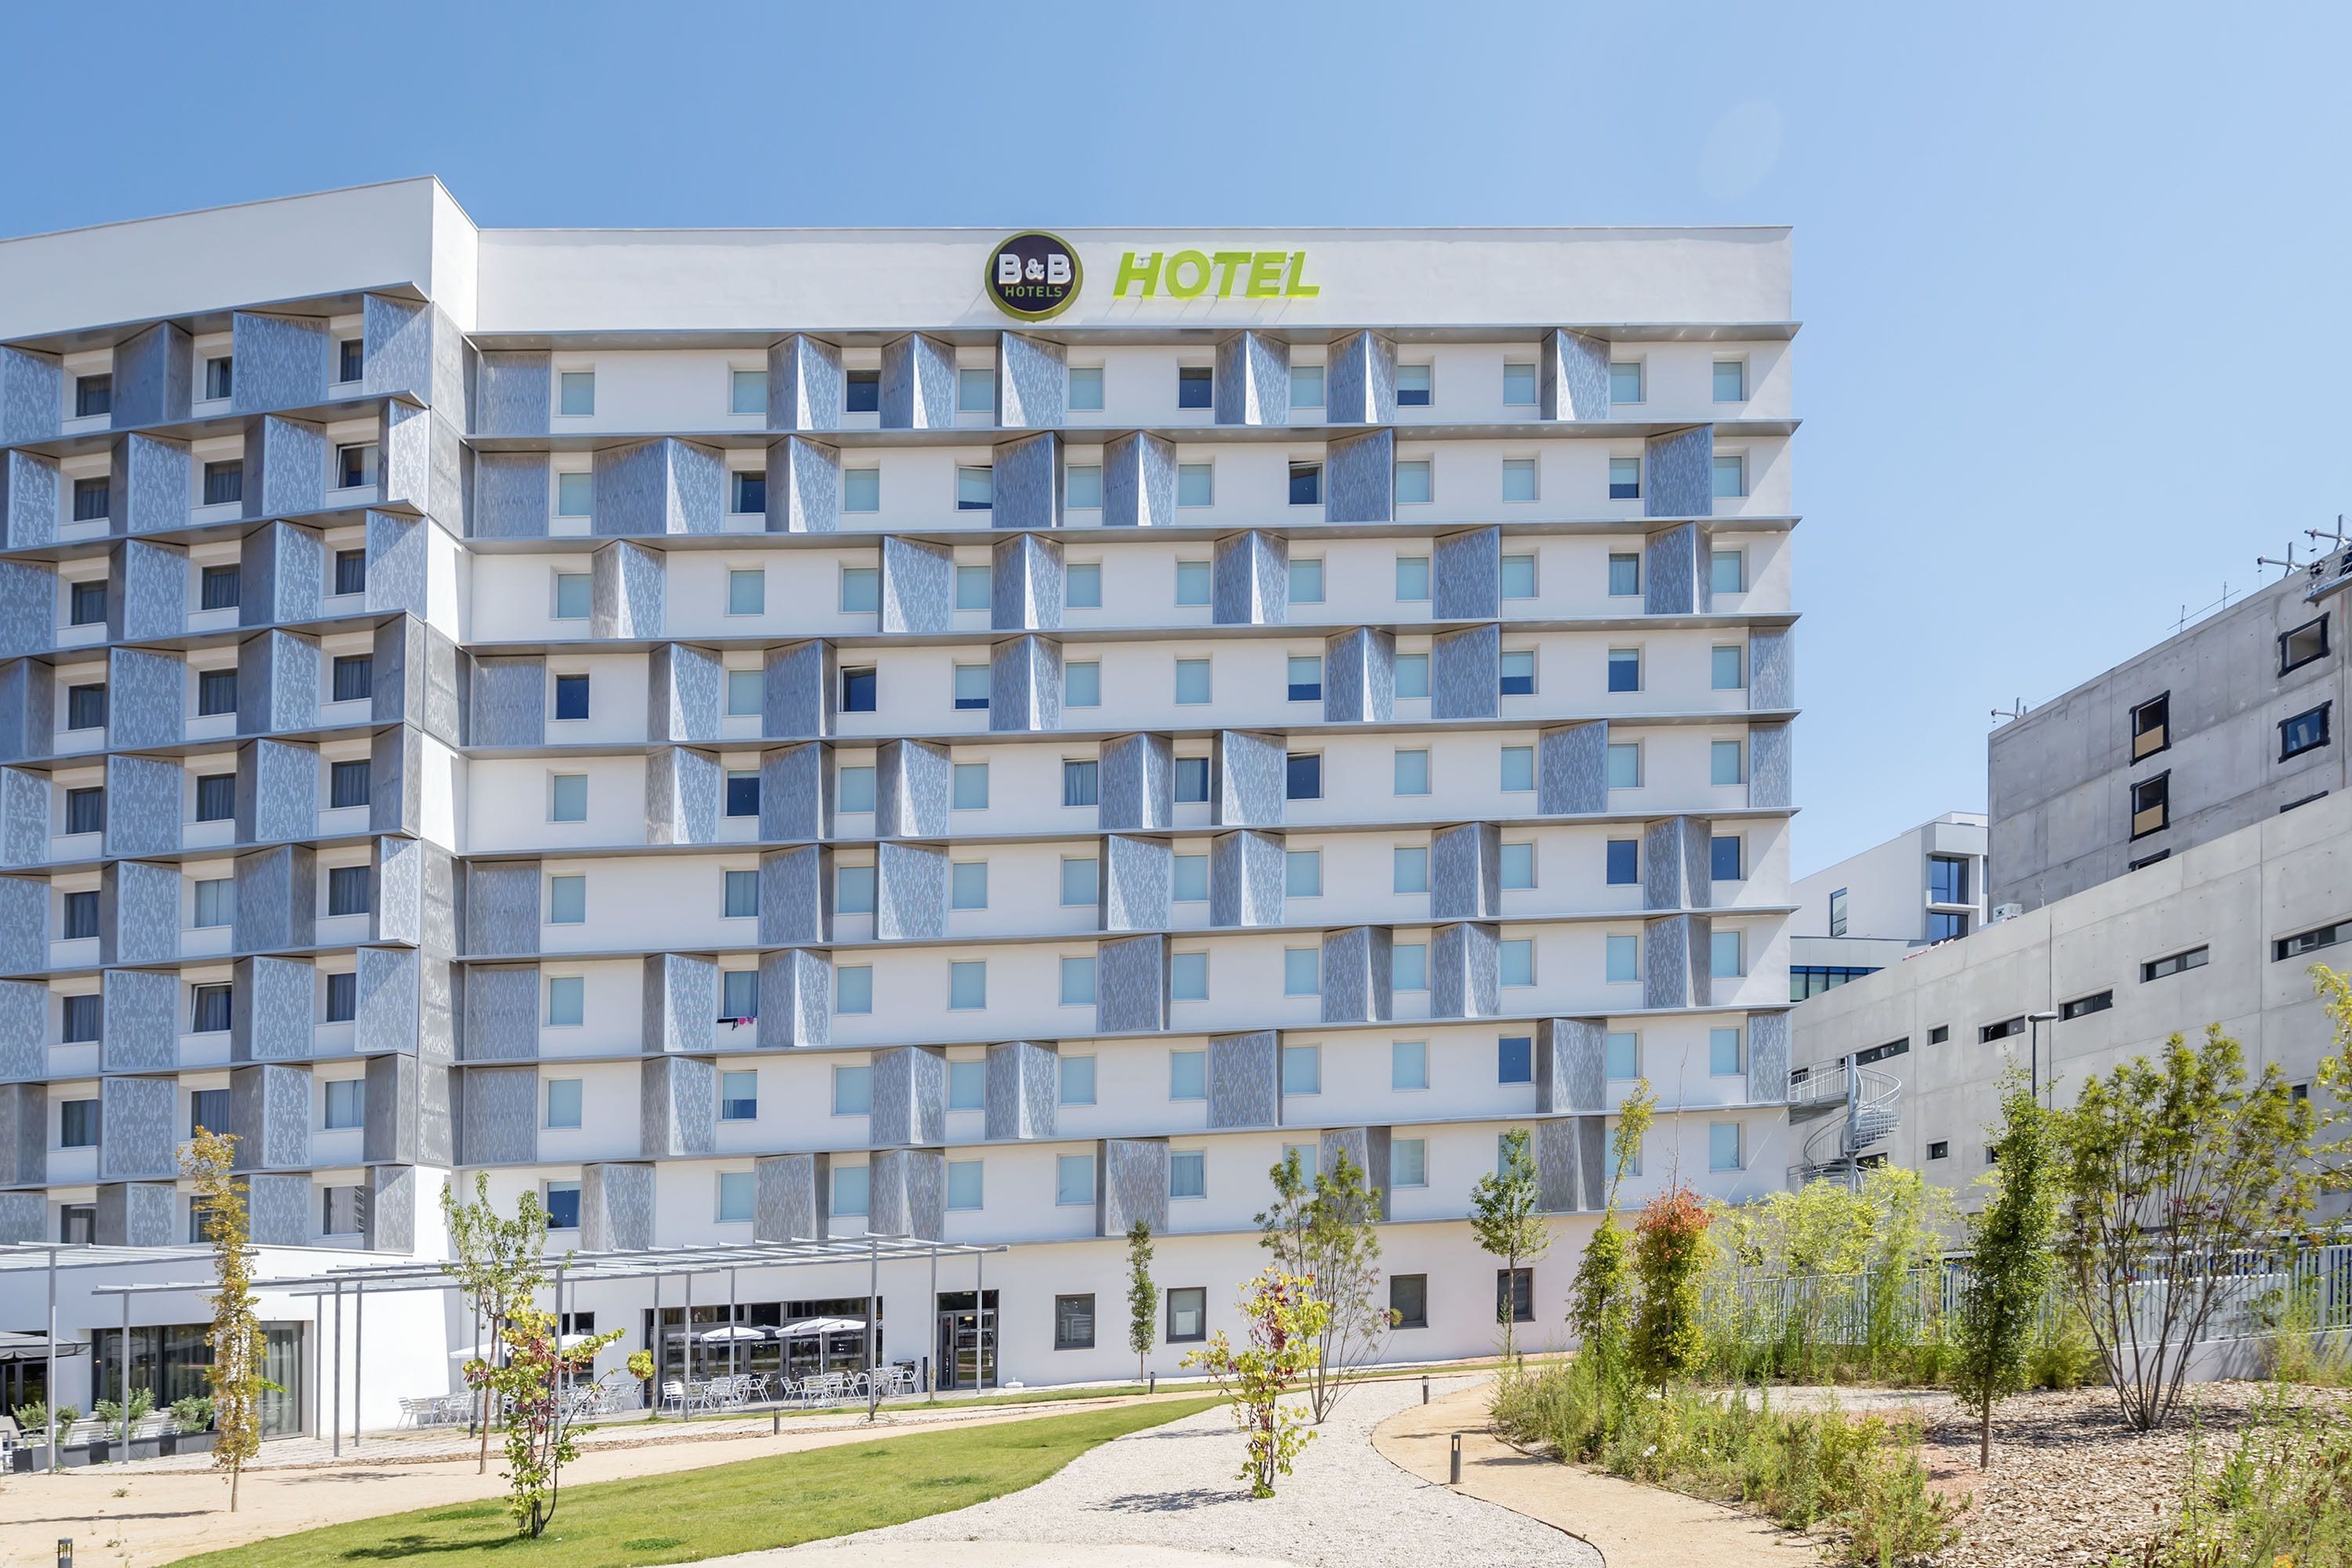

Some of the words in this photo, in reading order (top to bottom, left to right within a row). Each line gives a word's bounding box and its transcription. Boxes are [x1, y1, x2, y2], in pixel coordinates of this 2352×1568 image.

[998, 253, 1072, 285] B&B
[1112, 250, 1321, 299] HOTEL
[1005, 286, 1062, 297] HOTELS
